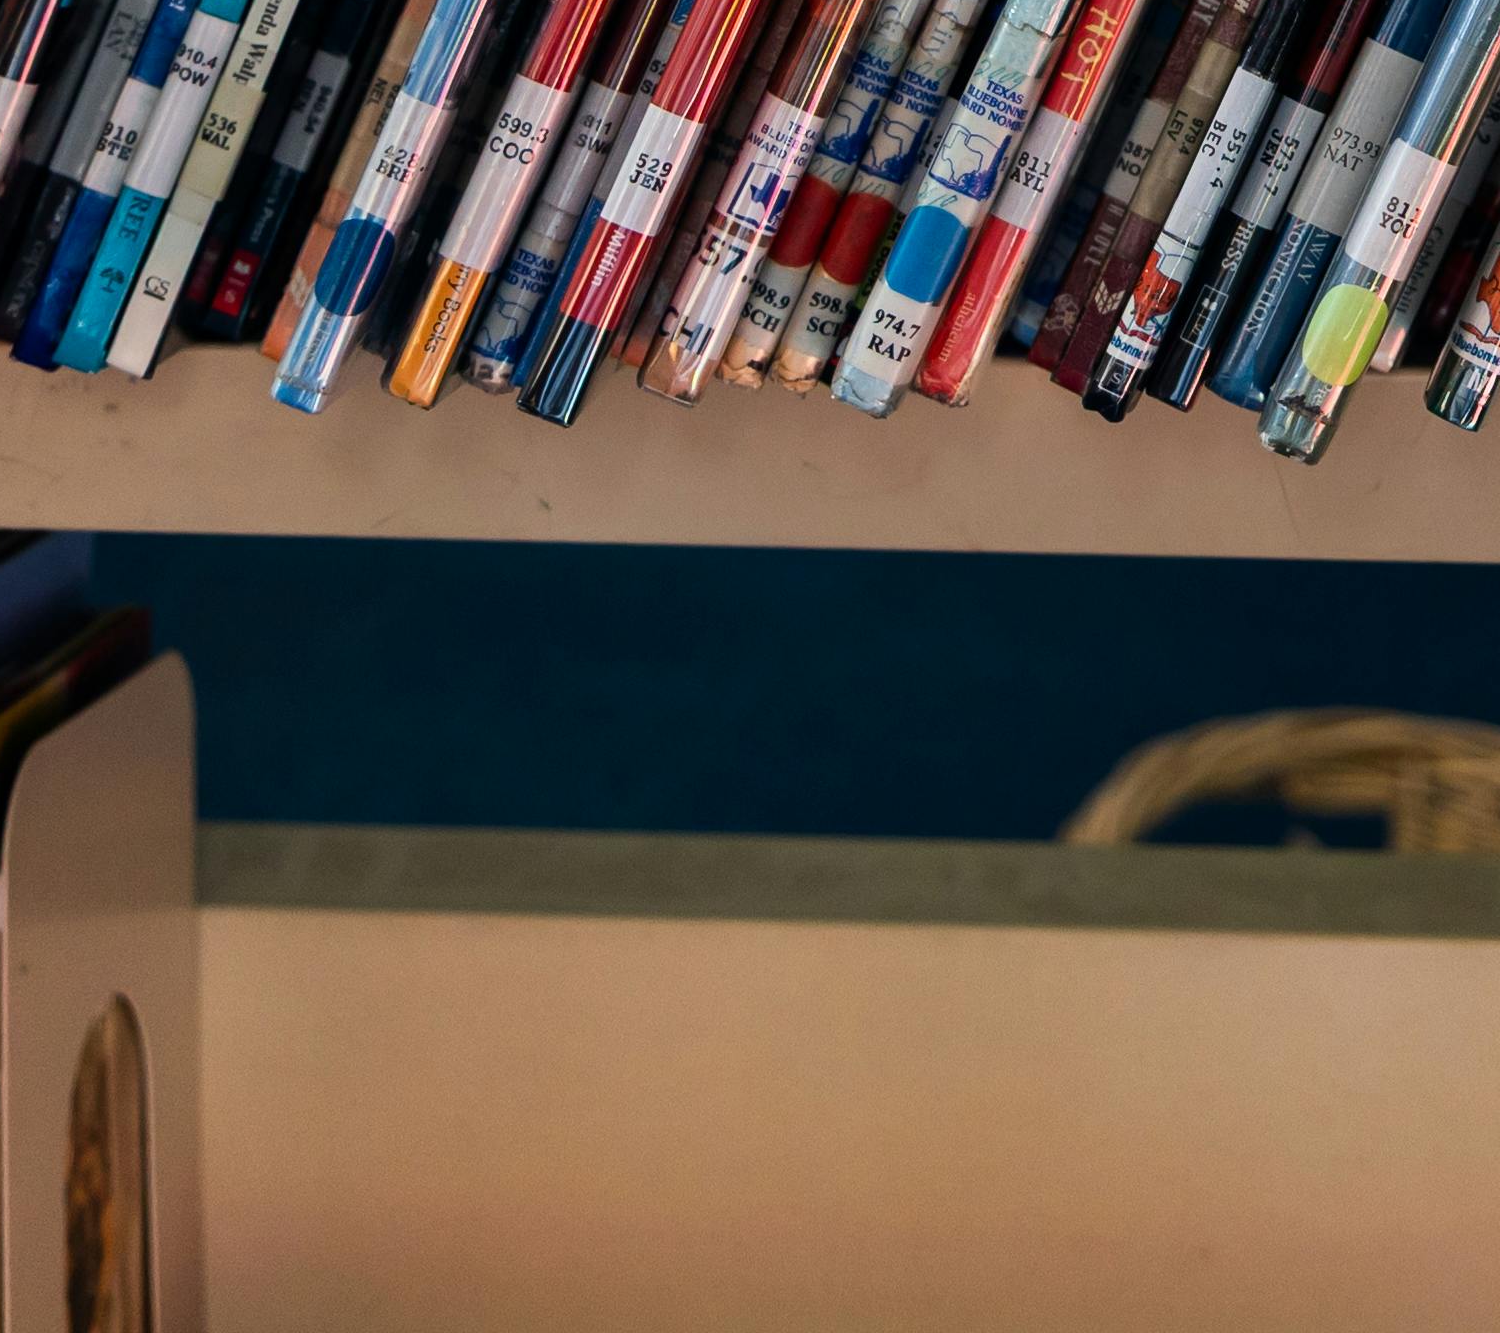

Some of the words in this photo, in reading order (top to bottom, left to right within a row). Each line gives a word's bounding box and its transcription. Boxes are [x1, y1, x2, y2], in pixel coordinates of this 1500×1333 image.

[232, 39, 267, 88] Walp
[1057, 4, 1118, 89] HOT
[496, 111, 549, 145] 599.3
[1198, 118, 1227, 158] BEC
[486, 135, 536, 167] COO
[634, 152, 672, 178] 529
[1206, 126, 1247, 192] 551.4
[627, 169, 665, 195] JEN
[588, 227, 627, 289] Mifflin
[870, 308, 920, 340] 974.7
[935, 291, 978, 364] atheneum
[866, 334, 911, 364] RAP
